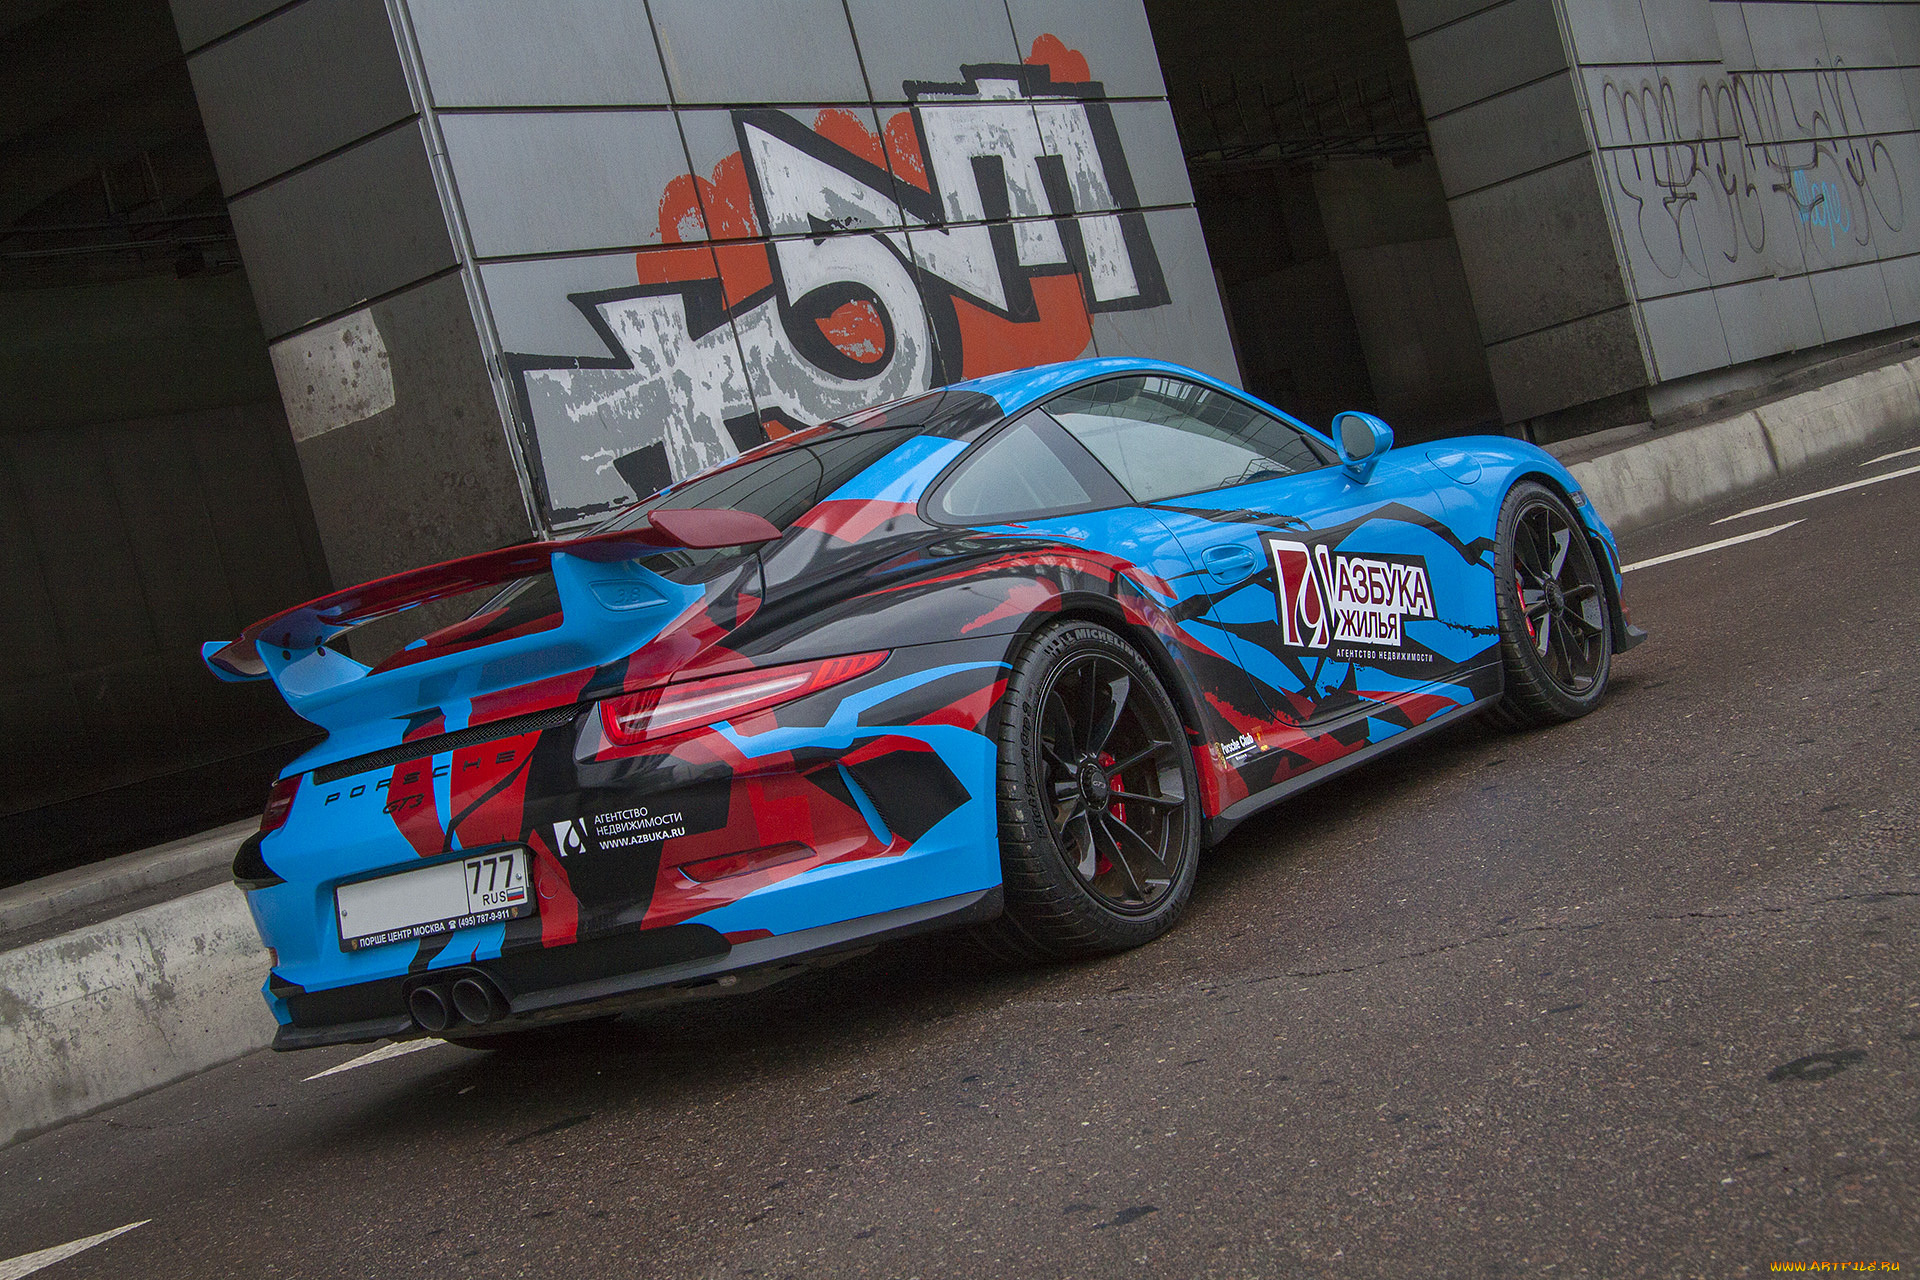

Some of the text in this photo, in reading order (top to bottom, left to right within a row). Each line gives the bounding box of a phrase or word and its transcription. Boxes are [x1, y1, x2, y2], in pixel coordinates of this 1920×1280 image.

[1337, 561, 1431, 612] АЗБУКА
[1338, 608, 1399, 641] ЖИЛЬЯ
[1074, 628, 1135, 657] MICHELIN
[1335, 648, 1434, 663] АГЕНТСТВО НЕДВИЖИМОСТИ
[324, 750, 516, 806] PORSCHE
[383, 793, 425, 815] GT3
[594, 806, 648, 825] АГЕНТСТВО
[596, 812, 683, 837] НЕДВИЖИМОСТИ
[599, 827, 686, 850] WWW.AZBUKA.RU
[467, 854, 515, 894] 777
[483, 890, 507, 906] RUS
[359, 909, 511, 948] ПОРШЕ ЦЕНТР МОСКВА (495) 787-9-911
